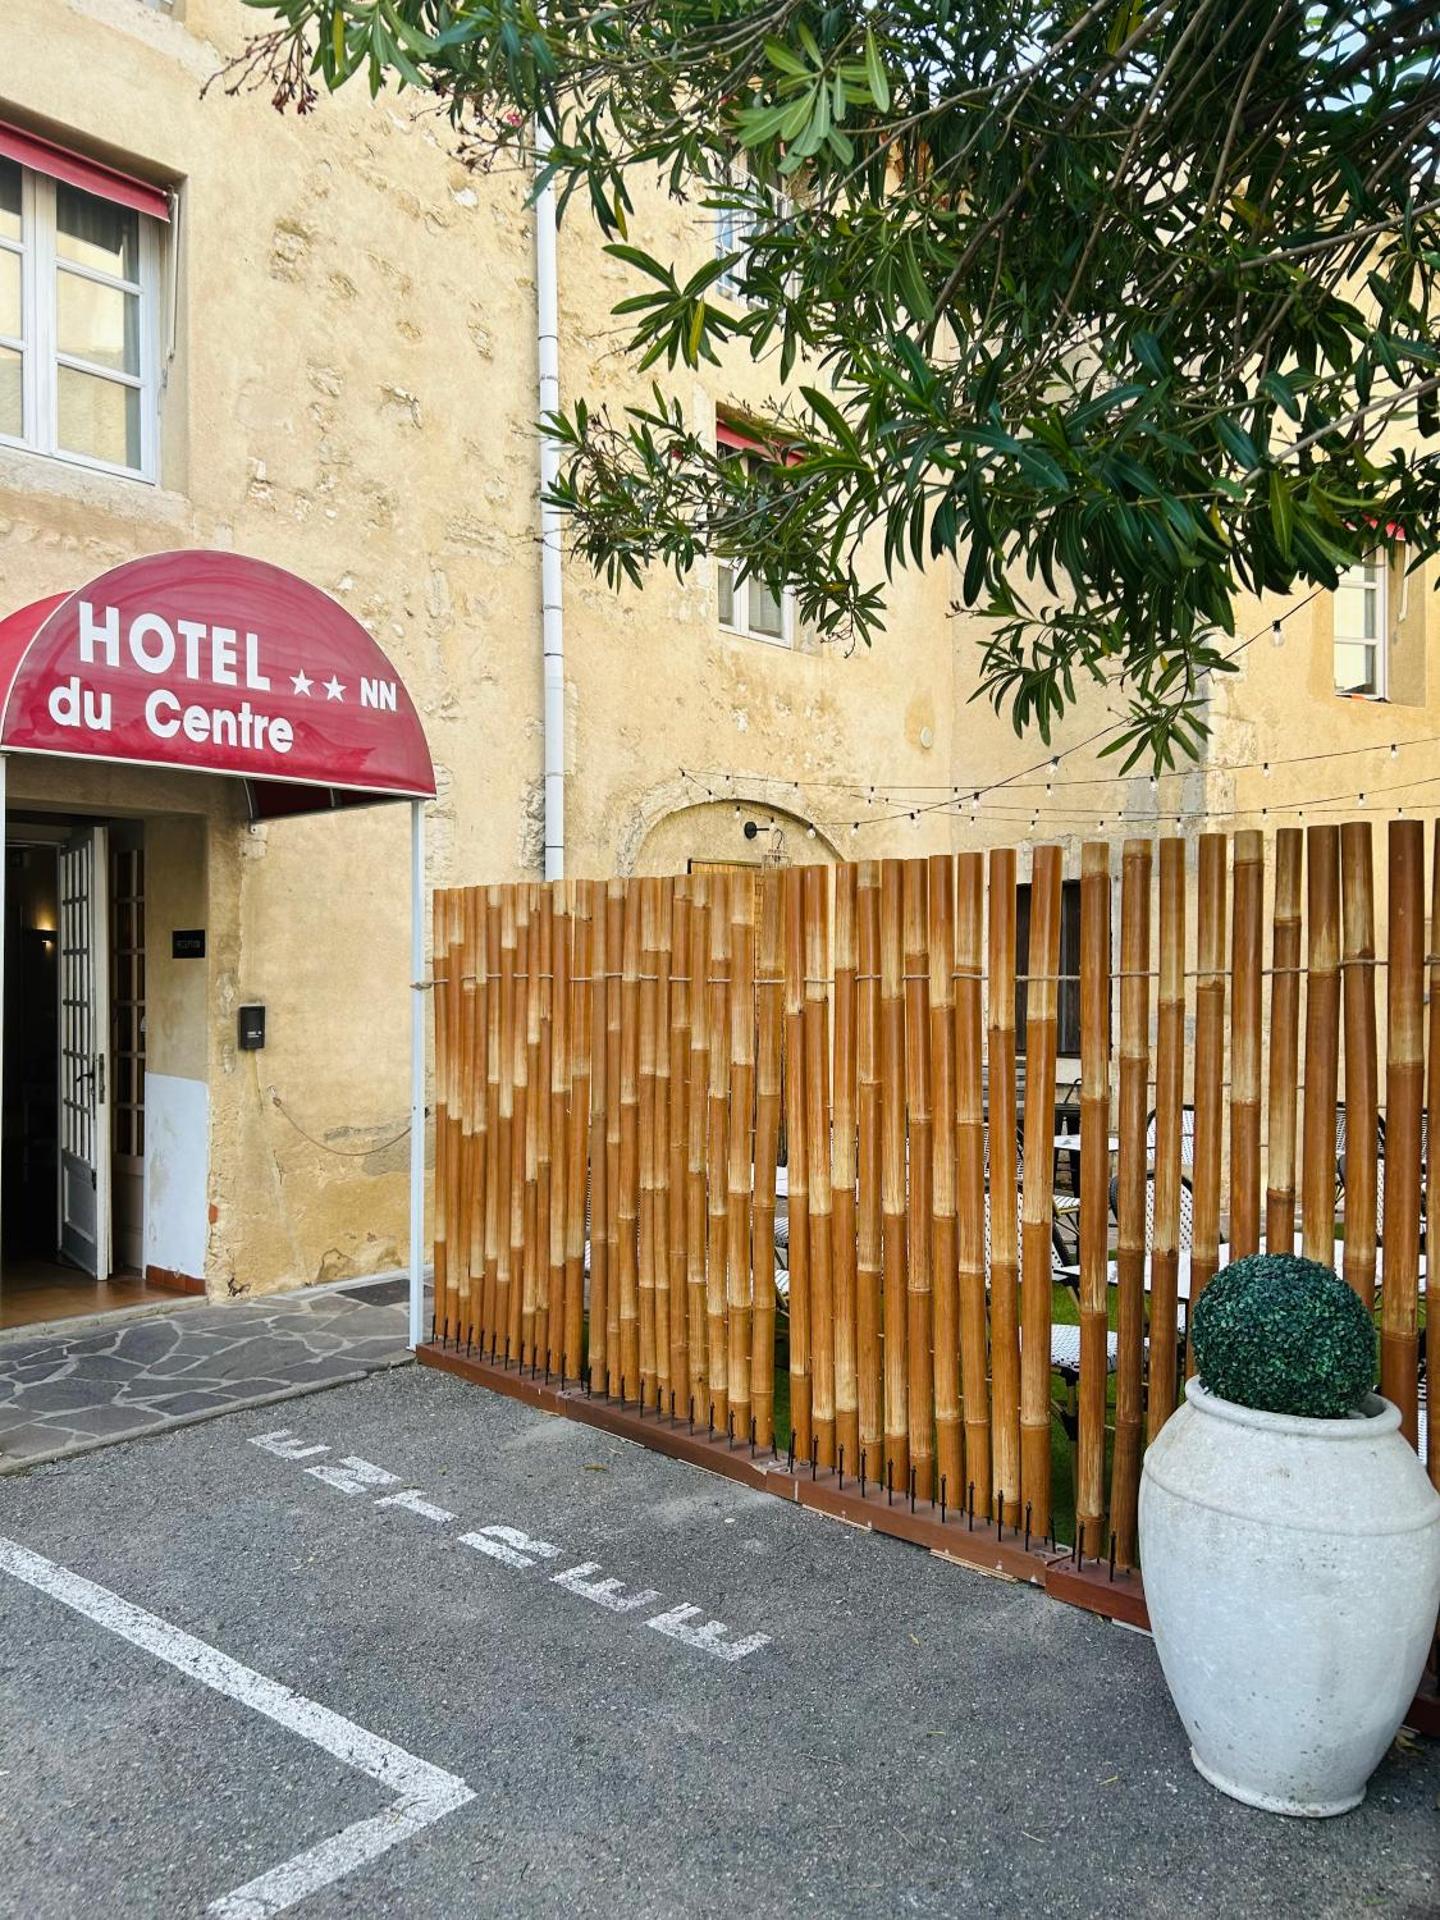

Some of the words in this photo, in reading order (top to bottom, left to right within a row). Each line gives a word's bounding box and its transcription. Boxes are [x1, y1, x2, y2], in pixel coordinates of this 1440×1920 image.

[79, 601, 270, 691] HOTEL
[360, 677, 397, 711] NN
[48, 677, 112, 730] du
[145, 689, 294, 753] Centre
